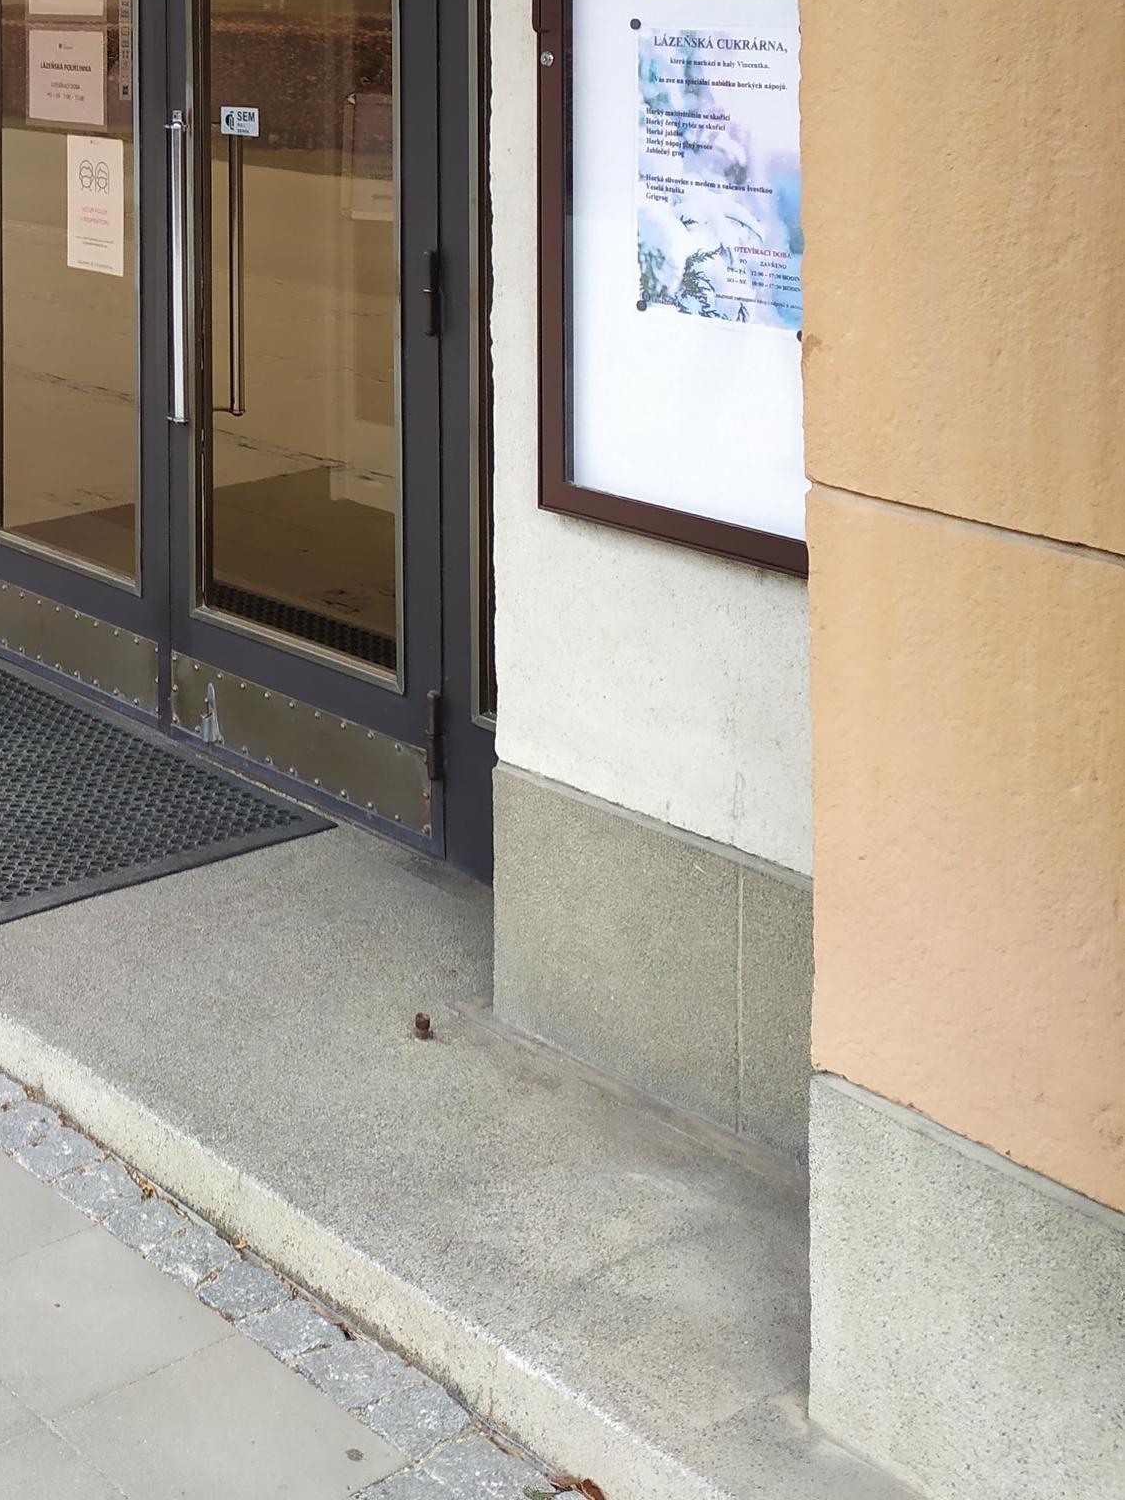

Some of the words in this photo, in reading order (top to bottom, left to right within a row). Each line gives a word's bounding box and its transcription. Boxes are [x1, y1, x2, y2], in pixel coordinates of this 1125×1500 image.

[654, 33, 713, 49] LÁZEŇSKÁ
[716, 36, 788, 53] CUKRÁRNA,
[237, 111, 255, 122] SEM
